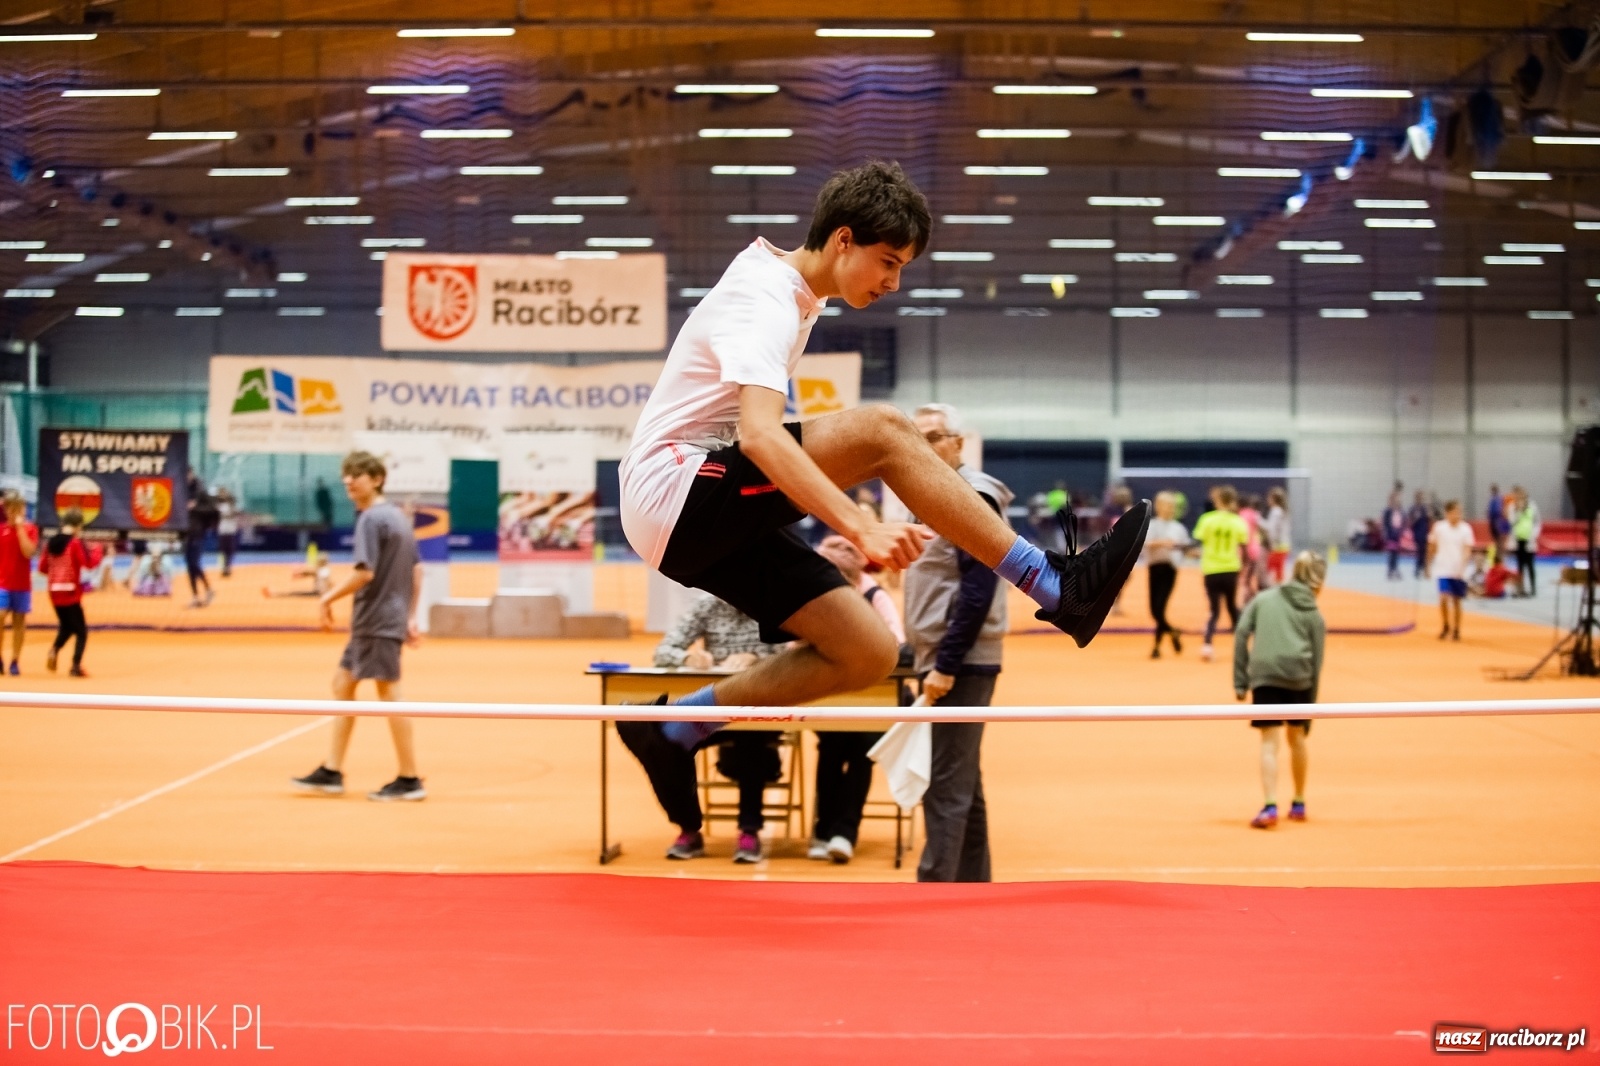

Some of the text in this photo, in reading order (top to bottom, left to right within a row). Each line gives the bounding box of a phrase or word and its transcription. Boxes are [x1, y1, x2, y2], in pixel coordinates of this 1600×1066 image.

[492, 279, 573, 295] MIASTO
[493, 297, 641, 325] Racibórz
[369, 381, 499, 408] POWIAT
[58, 431, 172, 453] STAWIAMY
[61, 453, 167, 475] NA SPORT
